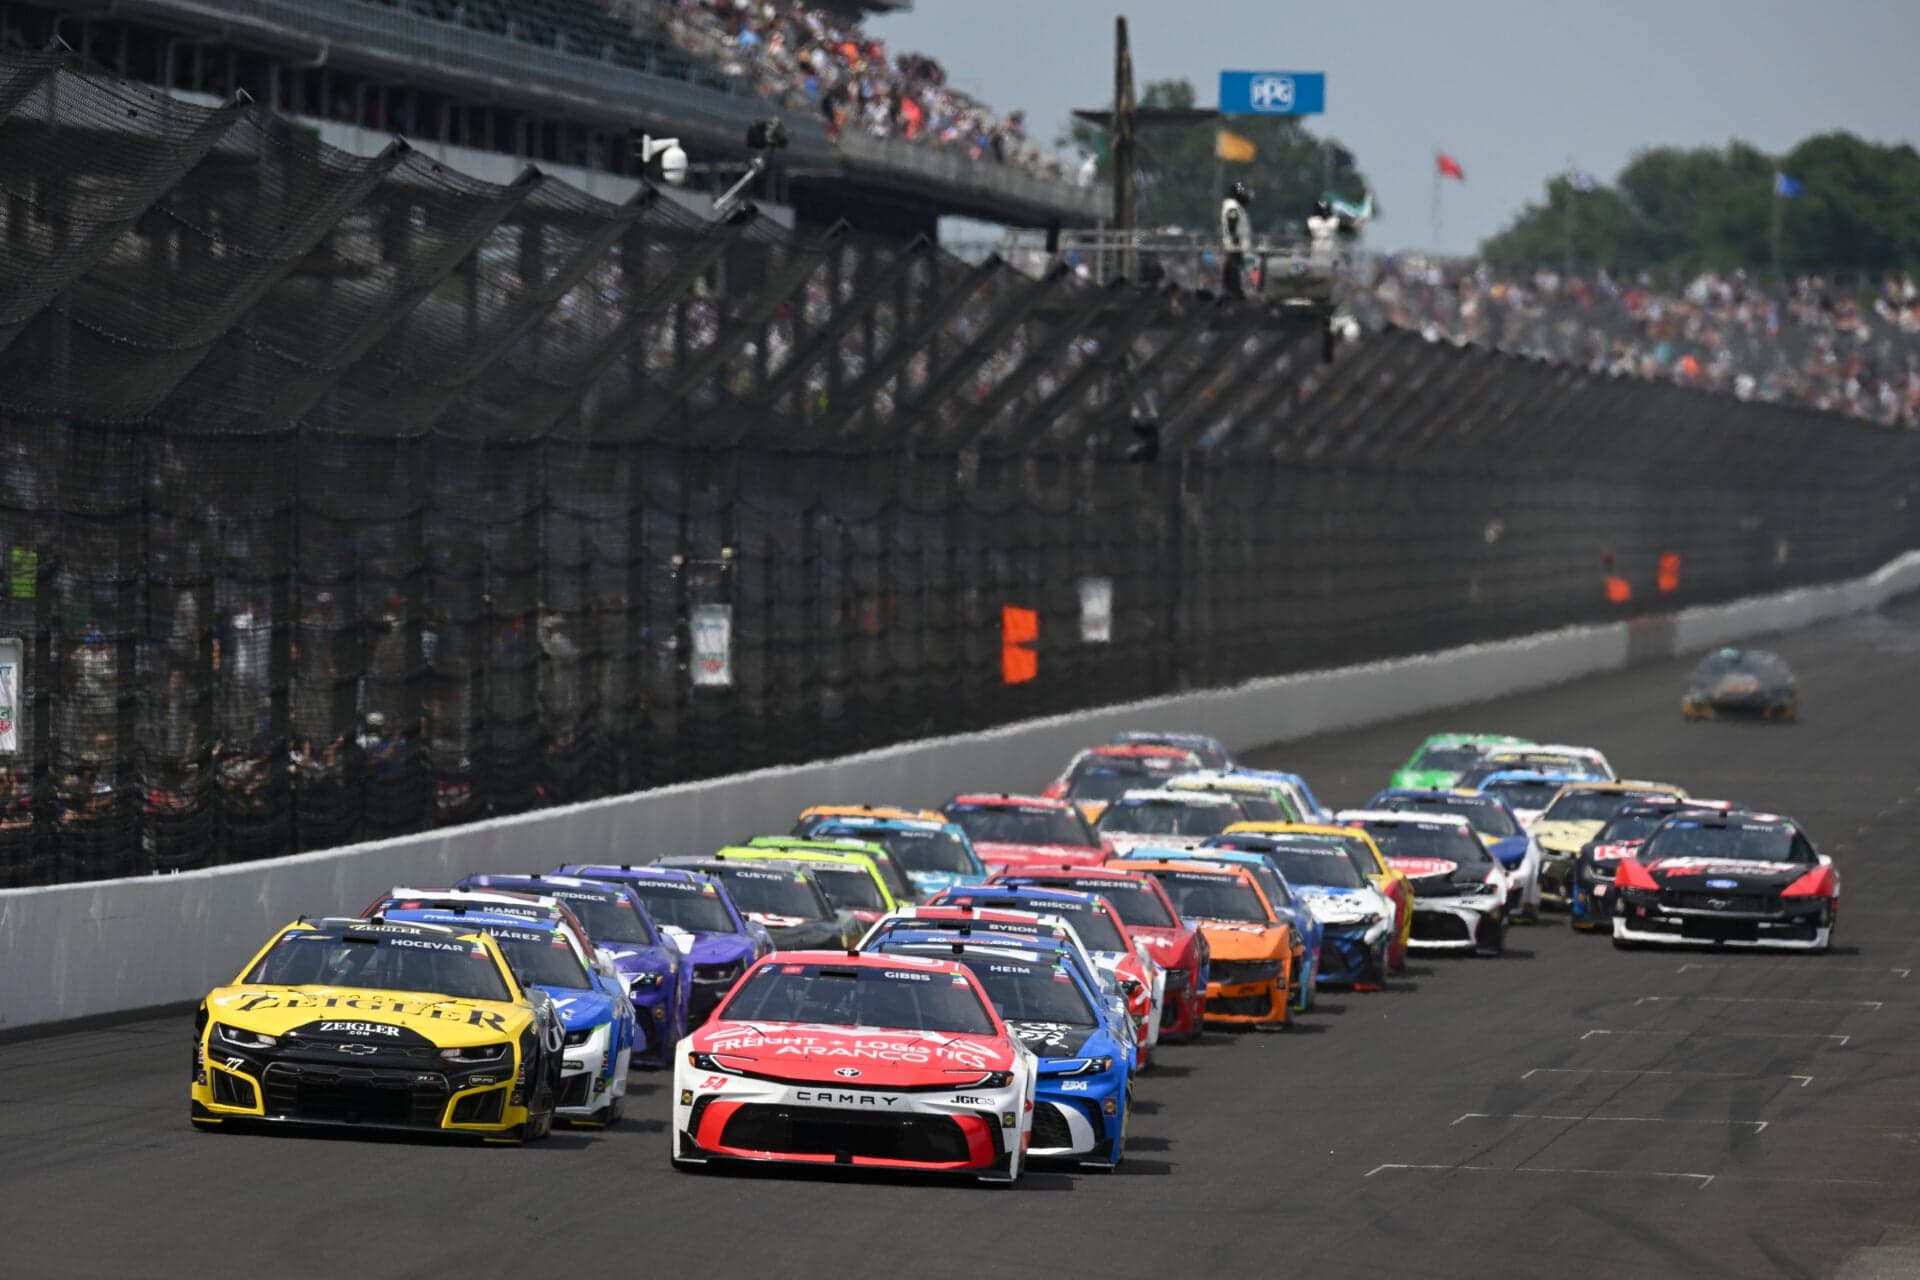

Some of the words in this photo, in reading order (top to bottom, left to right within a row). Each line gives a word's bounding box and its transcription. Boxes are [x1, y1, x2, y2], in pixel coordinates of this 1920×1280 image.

[1252, 77, 1293, 109] PPG
[736, 871, 783, 881] CUSTER
[638, 881, 697, 892] BOWMAN
[483, 906, 538, 917] HAMLIN
[1029, 900, 1083, 911] BRISCOE
[354, 924, 422, 935] ZEIGLER
[490, 927, 541, 942] UÁREZ
[989, 923, 1038, 934] BYRON
[391, 939, 464, 952] HOCEVAR
[990, 964, 1031, 974] HEIM
[884, 971, 931, 981] GIBBS
[236, 993, 508, 1034] ZEIGLER
[319, 1021, 401, 1037] ZEIGLER
[712, 1037, 820, 1053] FREIGHT
[775, 1045, 929, 1063] ARANCO
[224, 1057, 244, 1071] 77
[698, 1076, 729, 1091] 54
[797, 1091, 899, 1106] CAMRY
